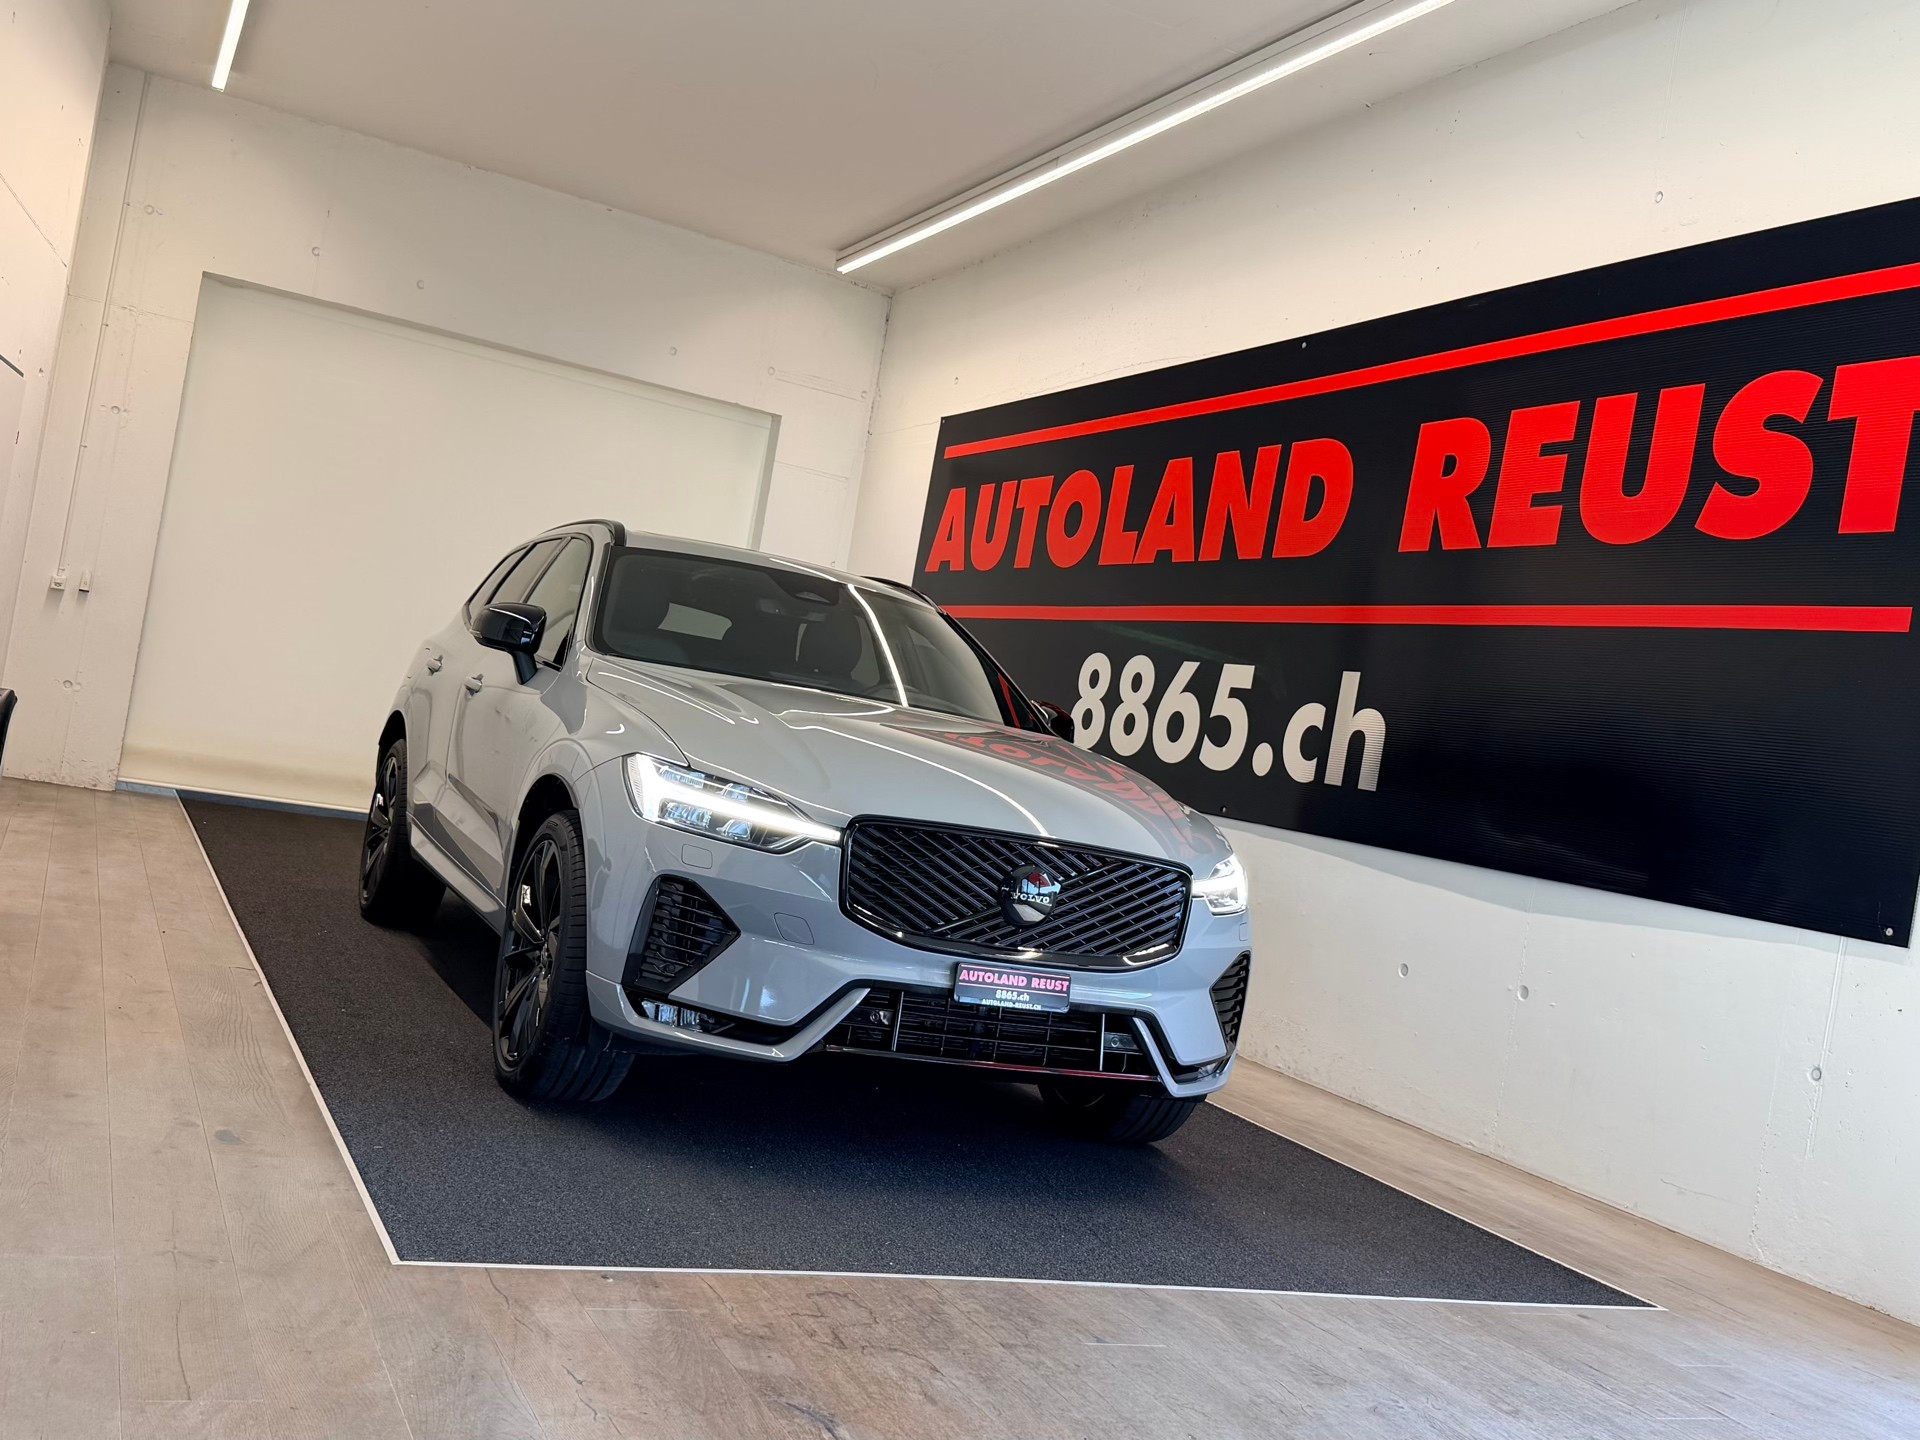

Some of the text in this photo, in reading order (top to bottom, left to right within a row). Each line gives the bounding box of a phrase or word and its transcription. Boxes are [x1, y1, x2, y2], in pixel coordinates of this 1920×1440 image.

[925, 355, 1920, 572] AUTOLAND REUST
[1071, 652, 1387, 791] 8865.ch
[1012, 890, 1050, 904] VOLVO
[959, 970, 1069, 991] AUTOLAND REUST
[995, 989, 1030, 1001] 8865.ch
